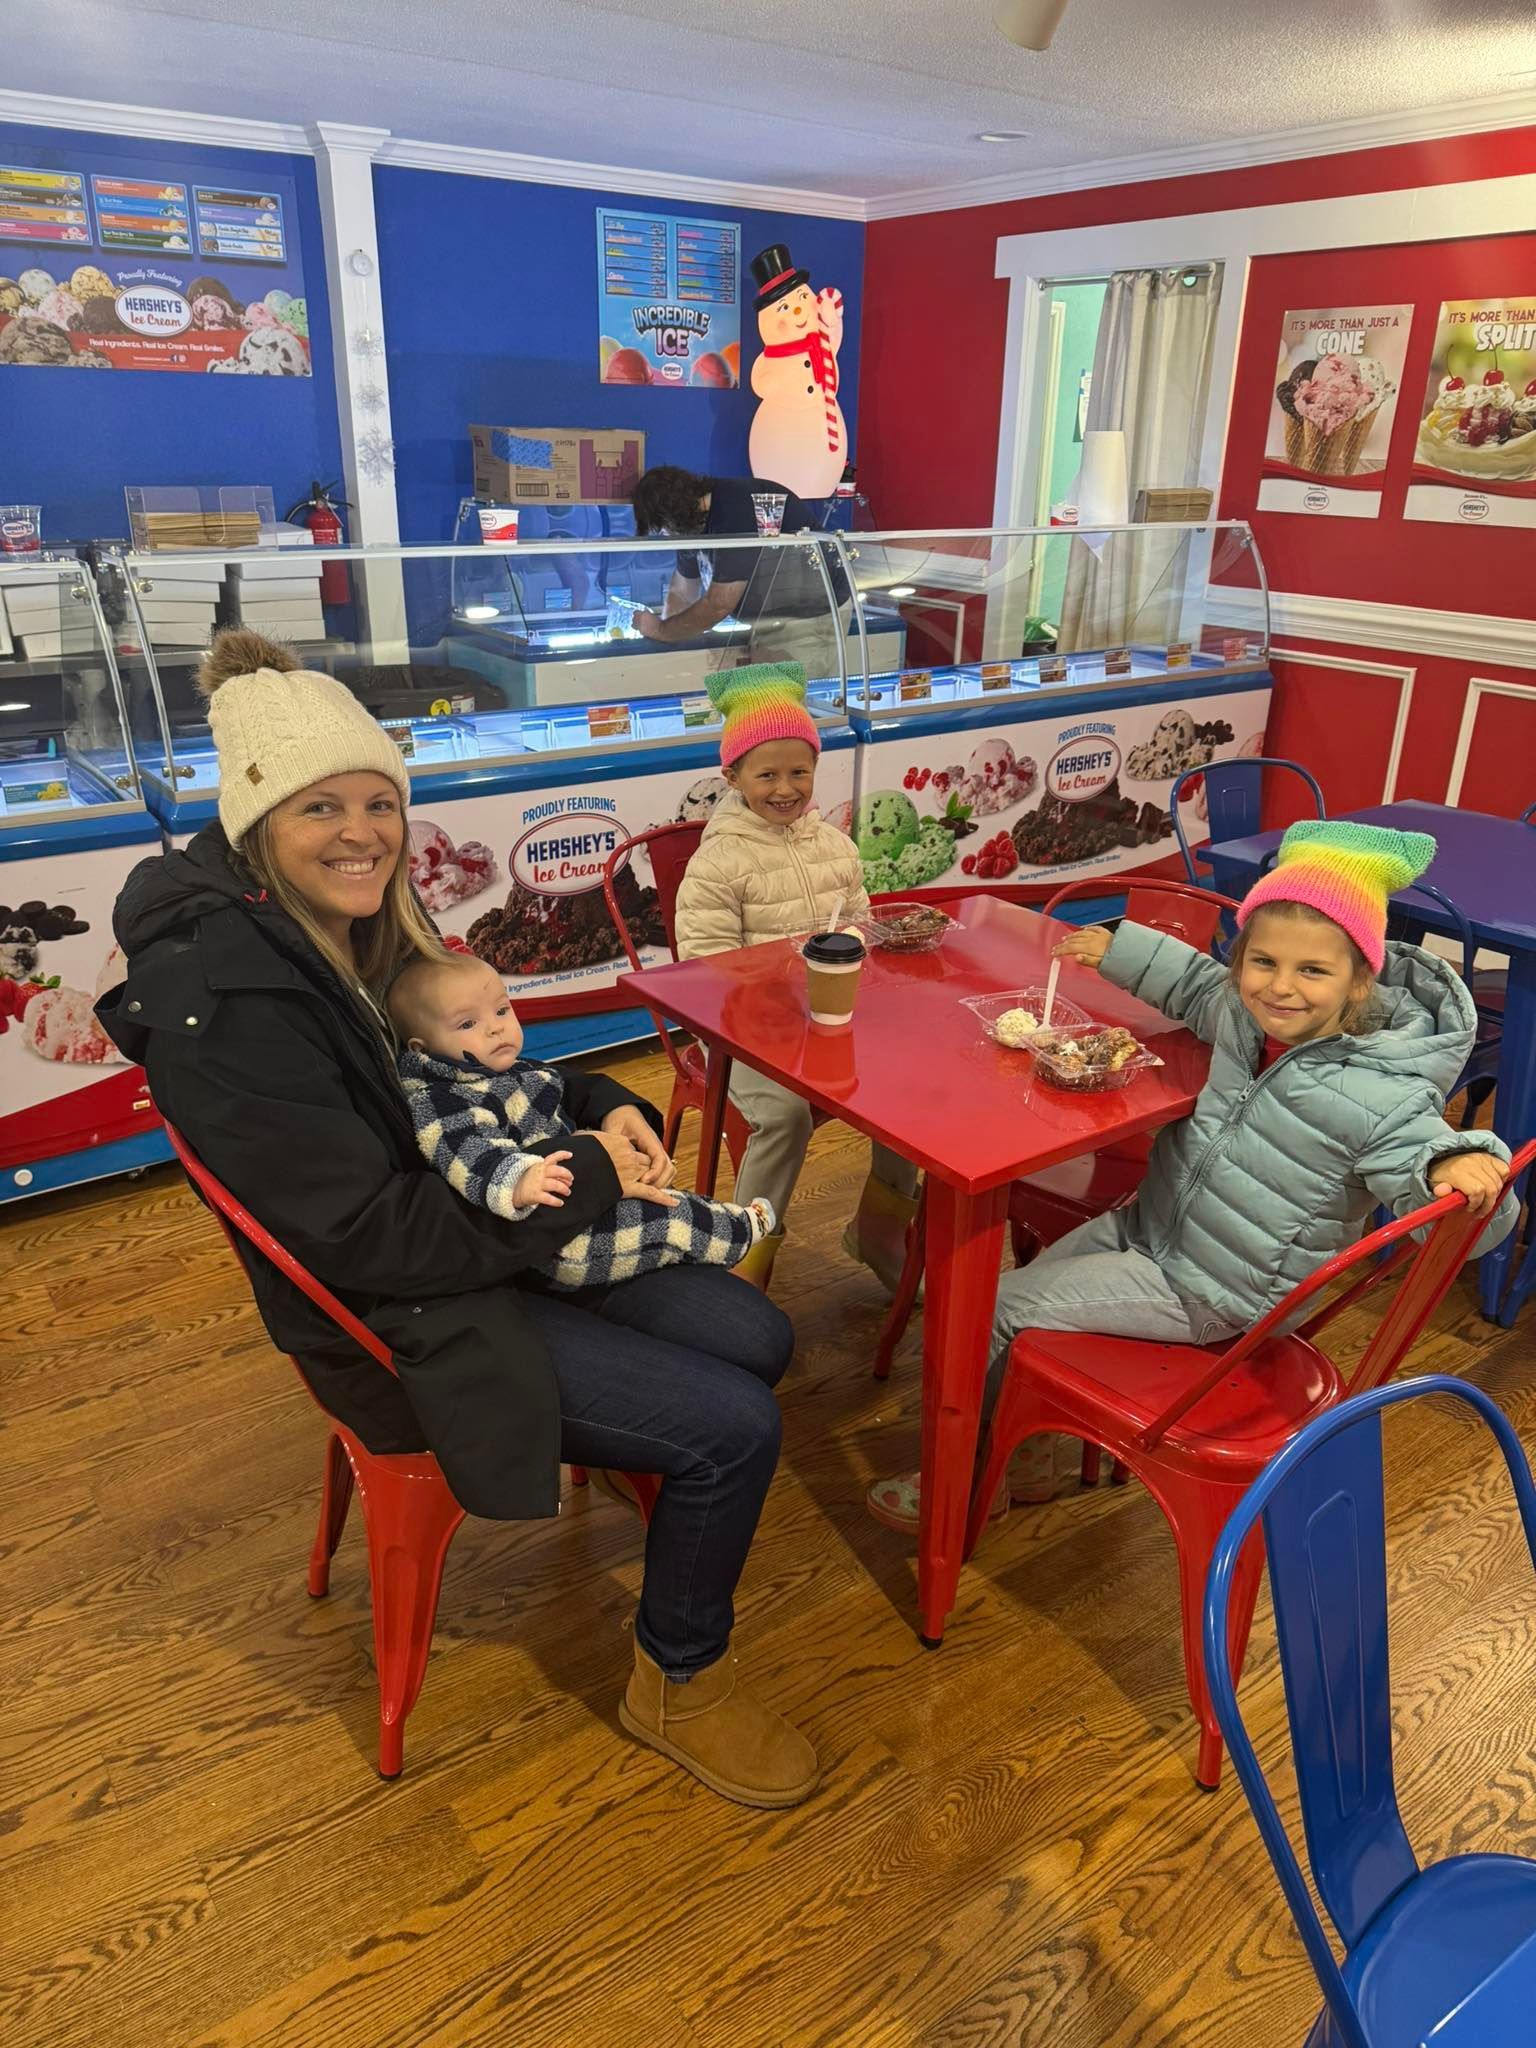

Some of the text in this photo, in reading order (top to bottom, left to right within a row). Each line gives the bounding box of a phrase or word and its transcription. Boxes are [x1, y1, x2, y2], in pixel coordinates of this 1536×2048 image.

[117, 269, 183, 287] Proudly Featuring
[125, 297, 182, 313] HERSHEY'S
[1449, 309, 1536, 323] IT'S MORE THAN
[131, 312, 182, 327] Ice Cream
[632, 305, 711, 335] INCREDIBLE
[1291, 317, 1399, 330] IT'S MORE THAN JUST A
[656, 328, 690, 356] ICE
[1316, 330, 1366, 356] CONE
[1475, 322, 1536, 352] SPLIT
[1058, 722, 1116, 744] PROUDLY FEATURING
[1056, 751, 1112, 775] HERSHEY'S
[1057, 774, 1106, 791] Ice Cream
[522, 796, 616, 824] PROUDLY FEATURING
[526, 830, 615, 863] HERSHEY'S
[533, 865, 556, 883] Ice
[508, 978, 554, 993] Ingredients.
[555, 974, 572, 982] Real
[573, 970, 584, 978] Ice
[586, 965, 610, 976] Cream.
[612, 960, 628, 969] Real
